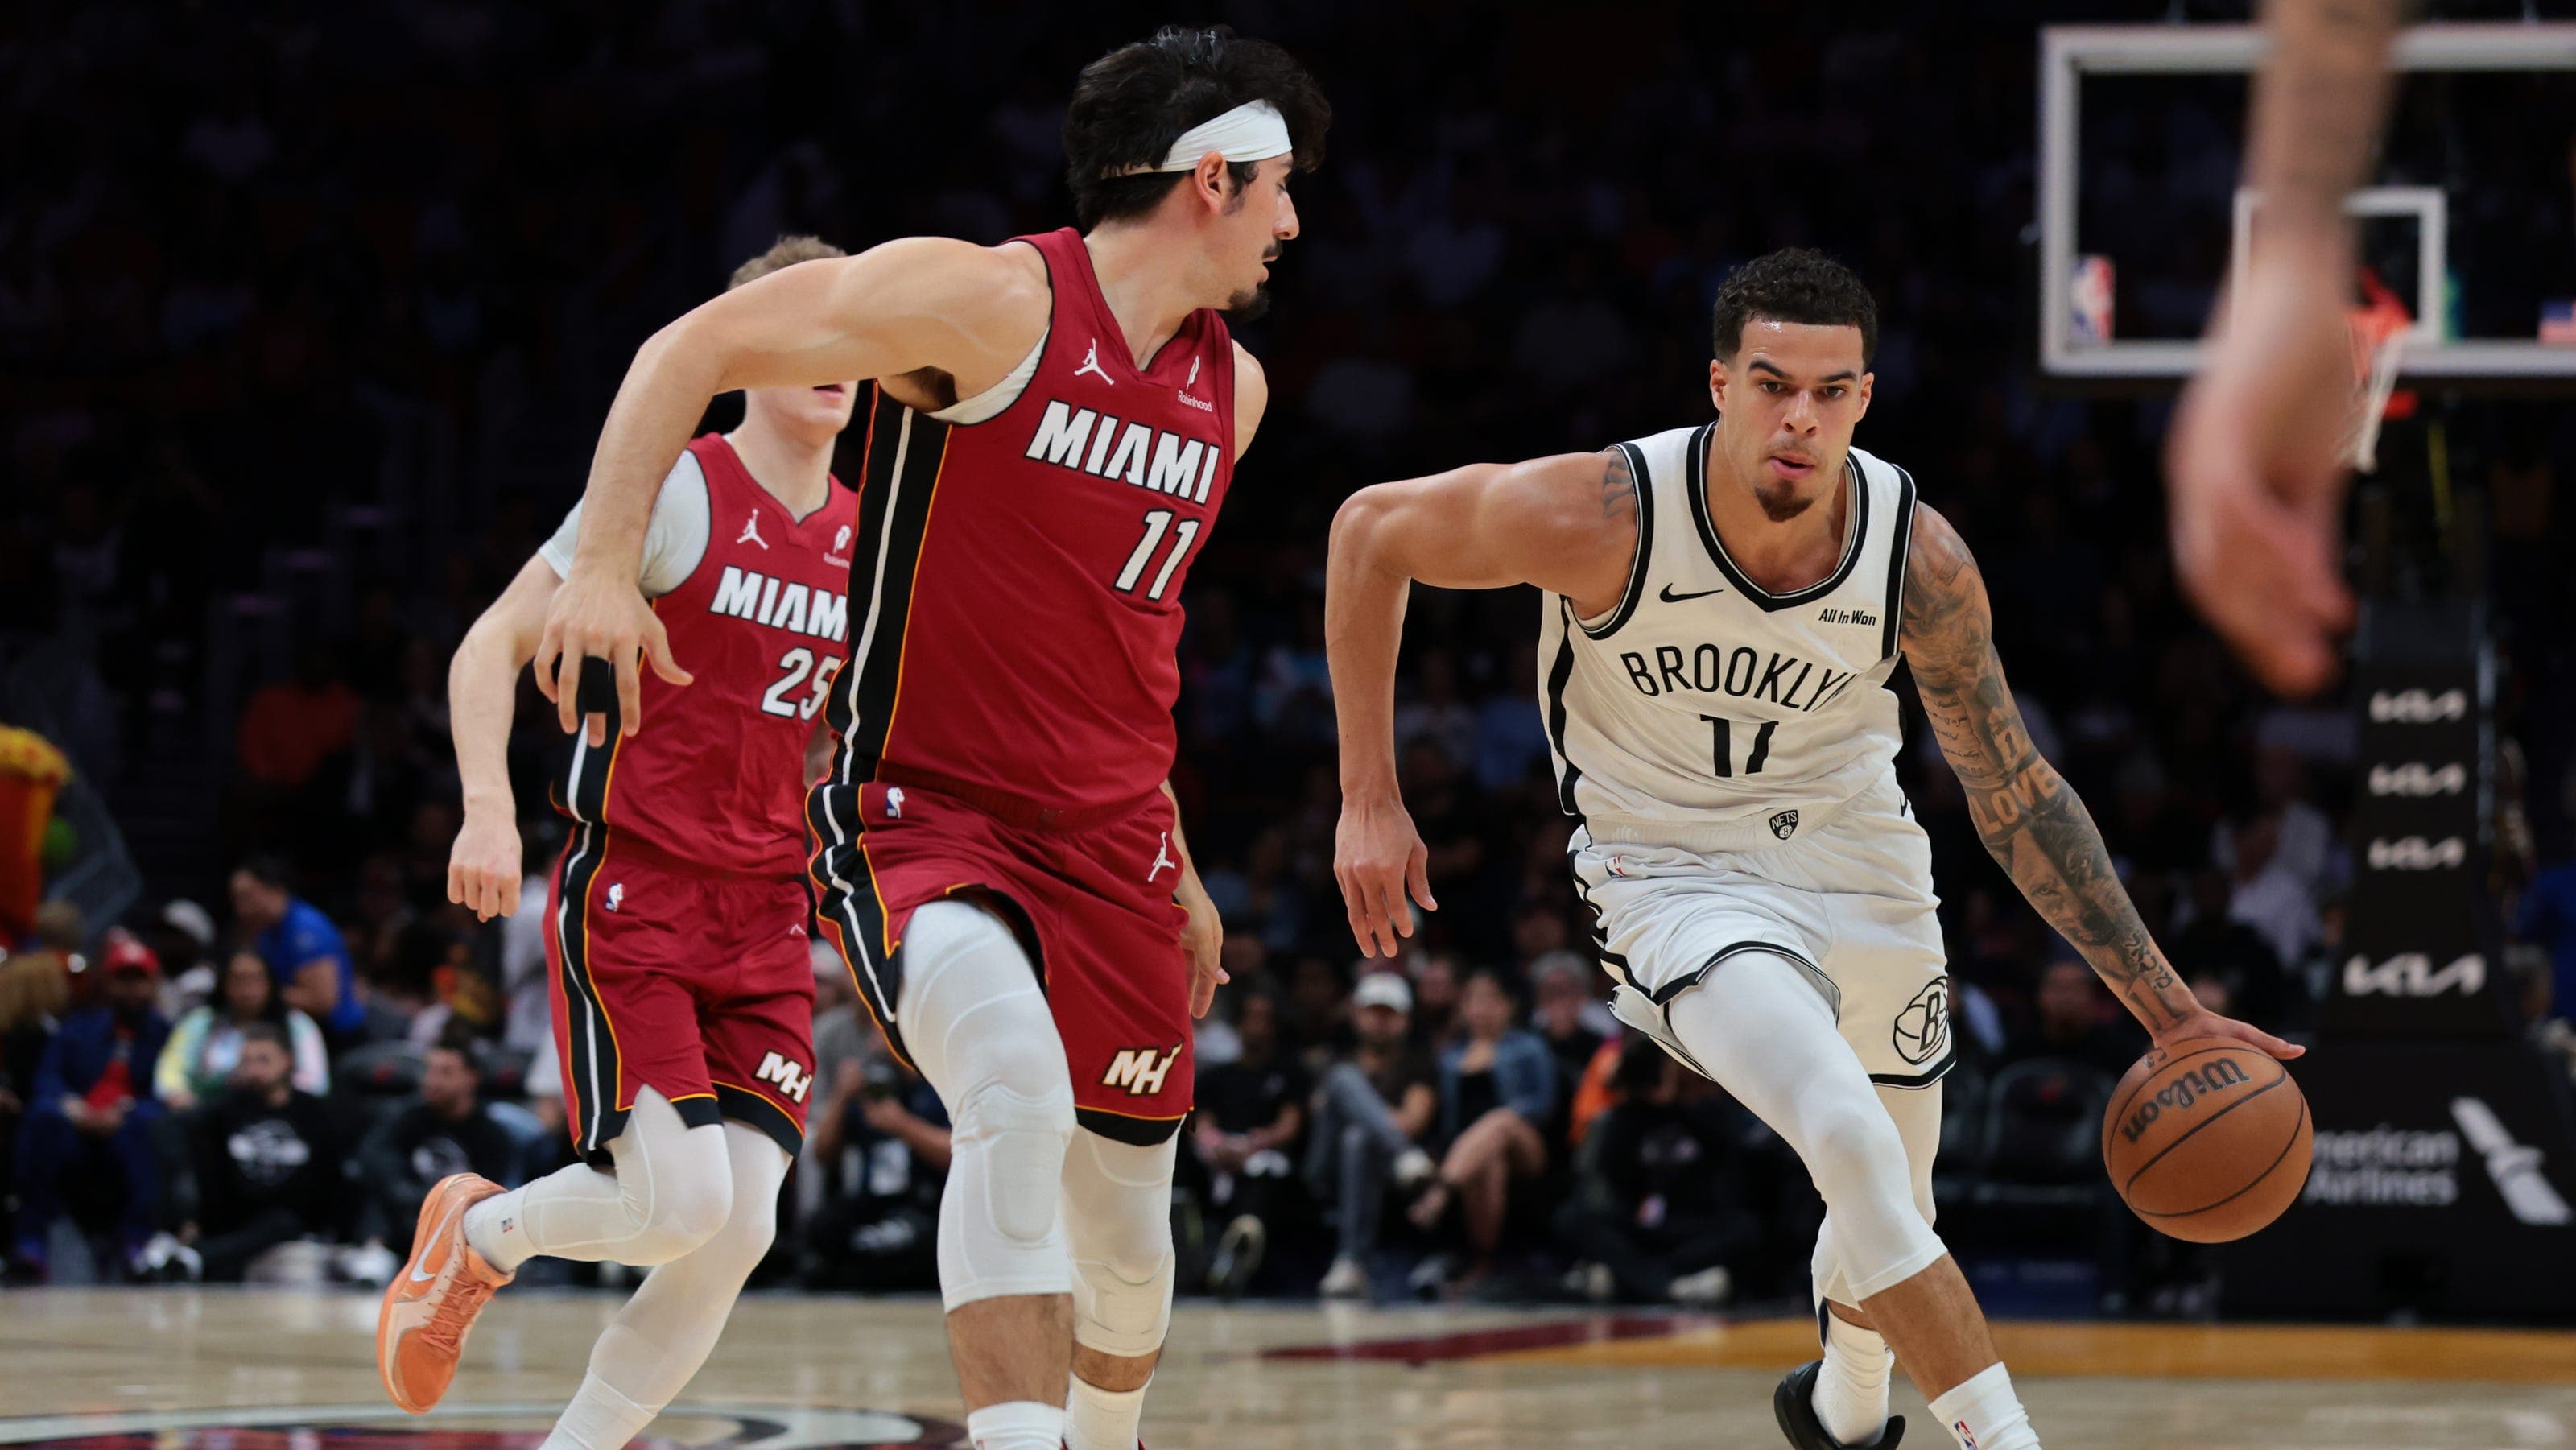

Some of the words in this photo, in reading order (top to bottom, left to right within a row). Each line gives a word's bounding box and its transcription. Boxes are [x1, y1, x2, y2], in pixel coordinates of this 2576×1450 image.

[1178, 390, 1212, 412] Robinhood
[1025, 399, 1220, 506] MIAMI
[1114, 509, 1200, 602] 11
[709, 565, 848, 642] MIAM
[1818, 608, 1838, 623] All
[1837, 610, 1850, 624] In
[1851, 610, 1876, 626] Won
[762, 647, 841, 721] 25
[1620, 643, 1857, 713] BROOKLY
[1771, 812, 1798, 830] NETS
[1968, 765, 2061, 836] LOVE
[2123, 1058, 2251, 1144] Wilson
